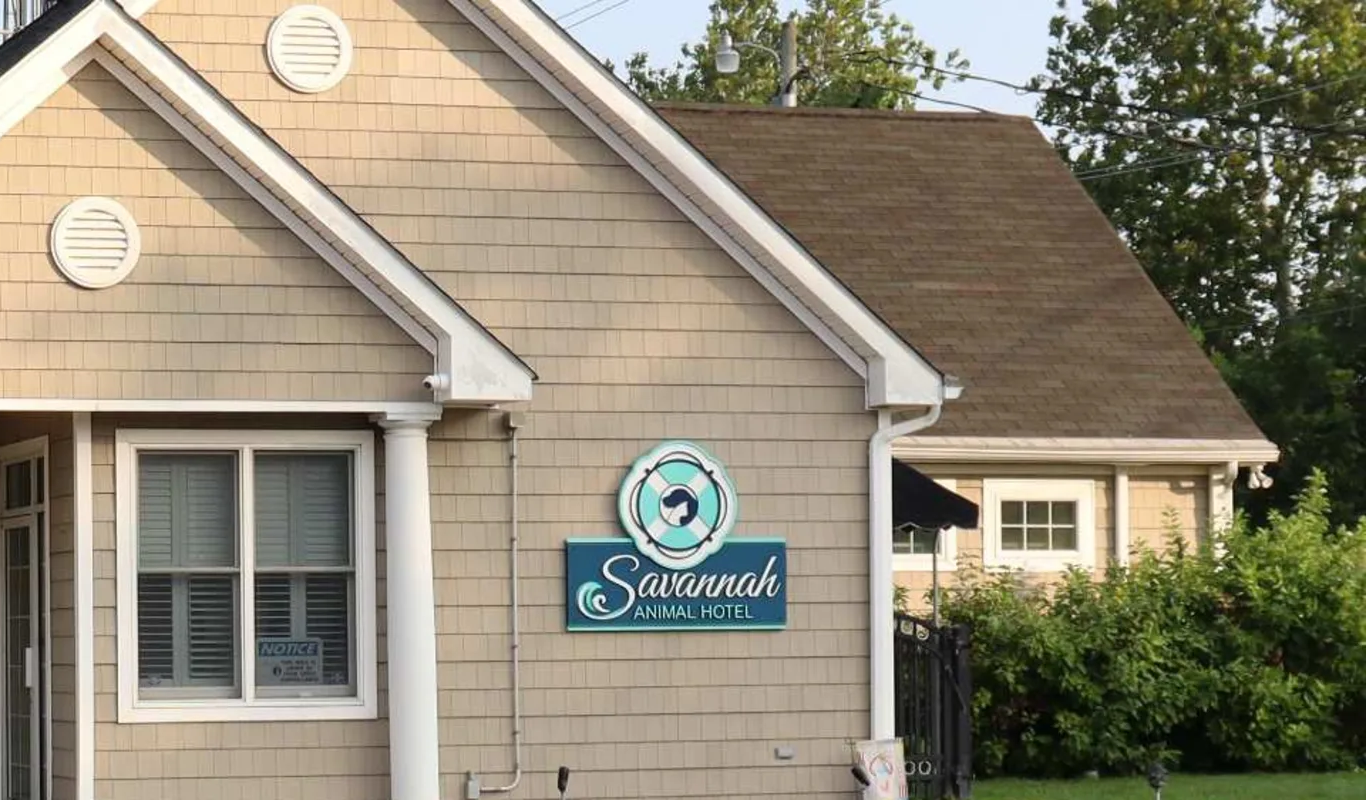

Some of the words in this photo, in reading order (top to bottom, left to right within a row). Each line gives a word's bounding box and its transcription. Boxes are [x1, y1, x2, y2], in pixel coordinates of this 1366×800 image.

[576, 554, 781, 620] Savannah
[634, 604, 696, 619] ANIMAL
[701, 604, 753, 619] HOTEL
[261, 643, 316, 654] NOTICE
